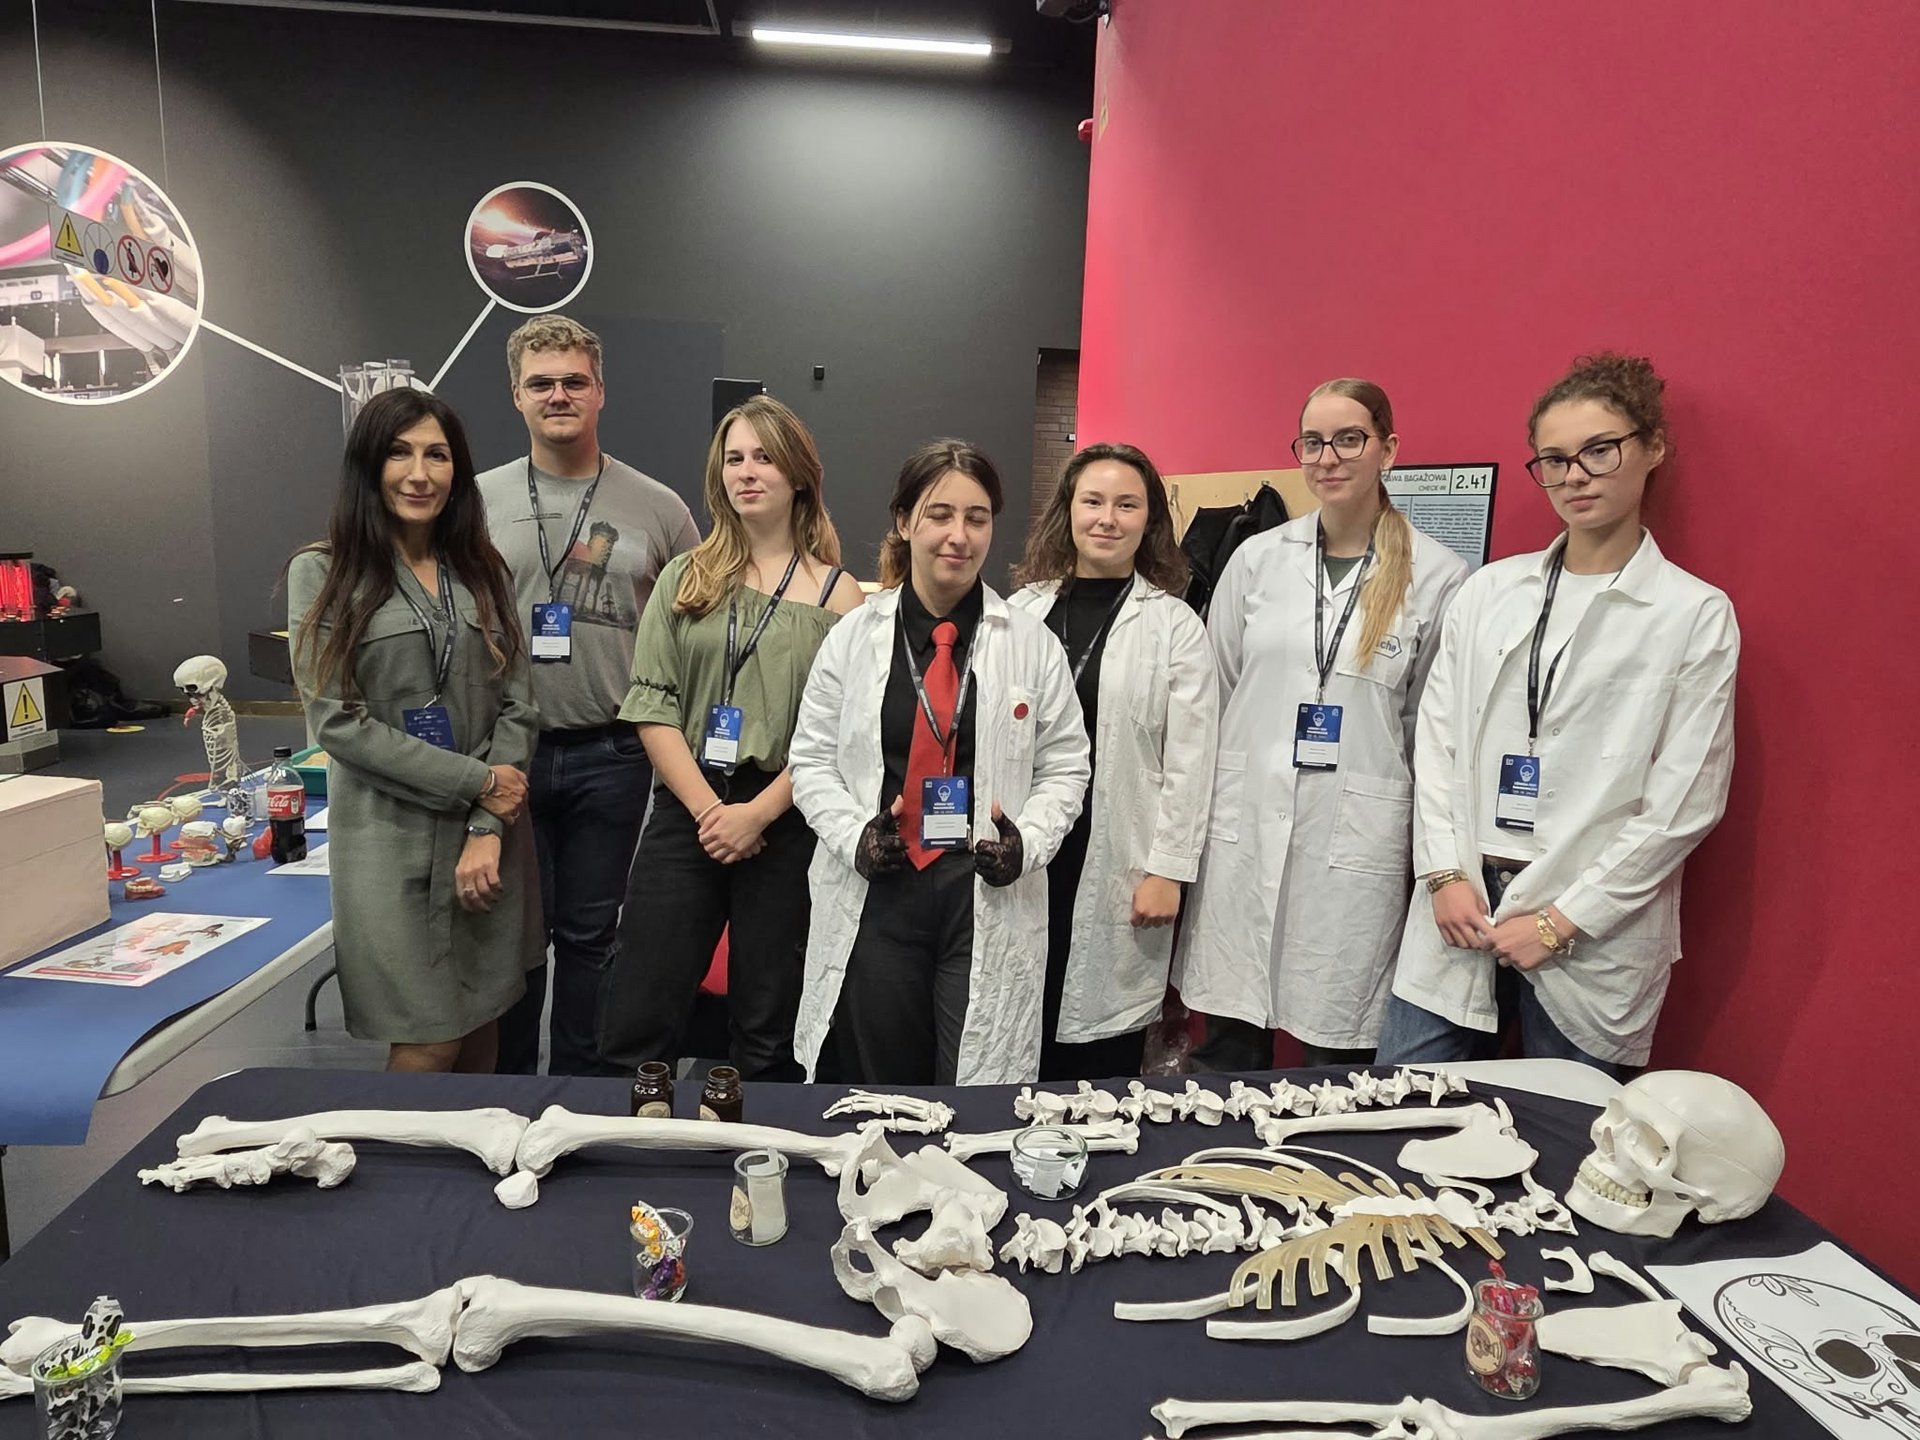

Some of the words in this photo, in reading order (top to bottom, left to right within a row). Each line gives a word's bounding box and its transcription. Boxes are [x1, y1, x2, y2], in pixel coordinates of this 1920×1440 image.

[1404, 471, 1447, 482] BAGAŻOWA
[1456, 474, 1487, 489] 2.41
[1380, 640, 1397, 652] che
